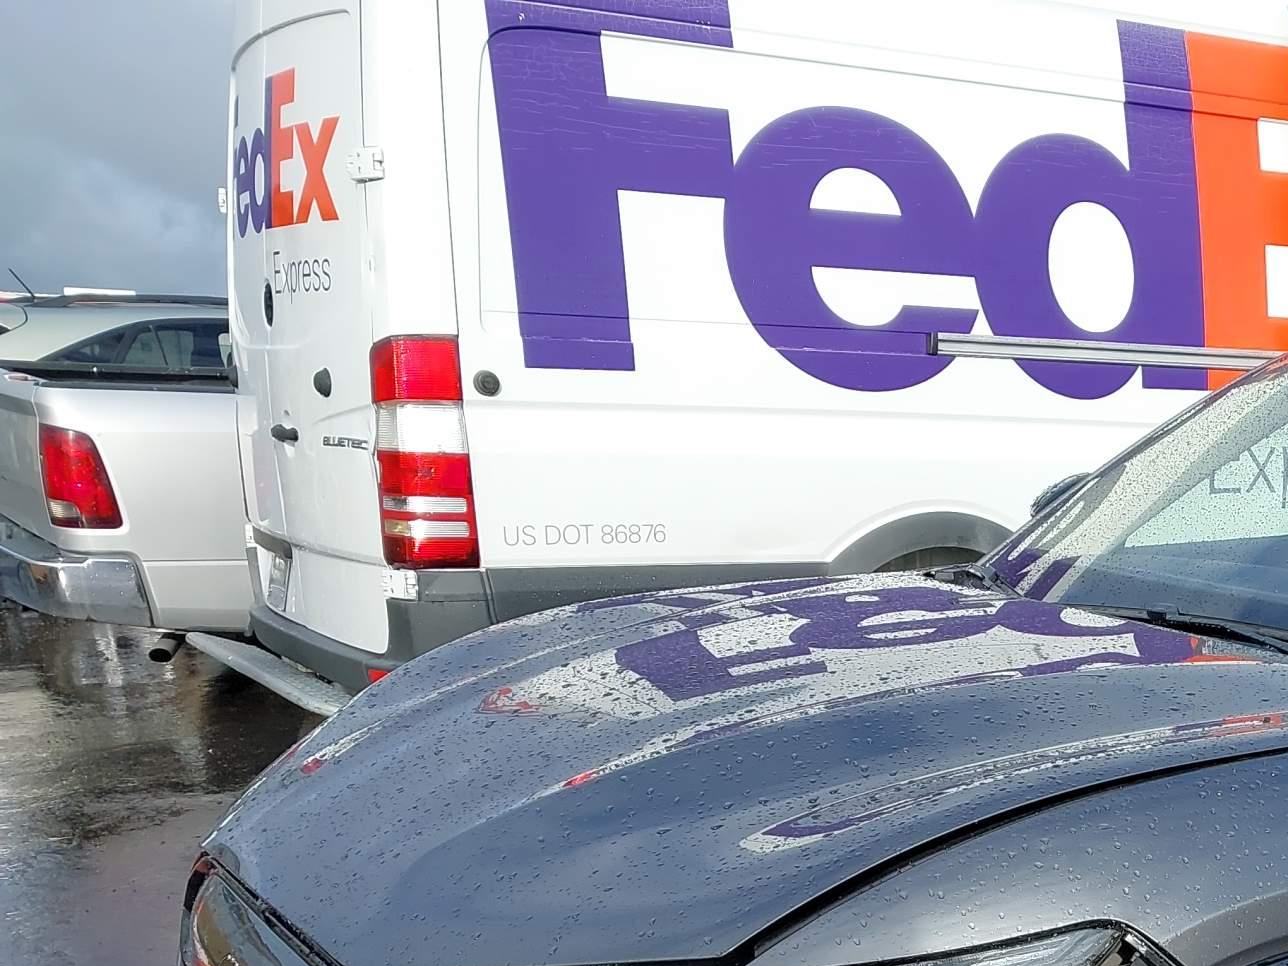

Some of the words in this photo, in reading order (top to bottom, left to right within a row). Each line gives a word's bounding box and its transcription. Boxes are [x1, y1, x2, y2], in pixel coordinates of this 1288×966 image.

[234, 67, 340, 239] edEx
[273, 251, 332, 304] Express
[503, 524, 537, 546] US
[544, 524, 595, 545] DOT
[600, 523, 667, 544] 86876
